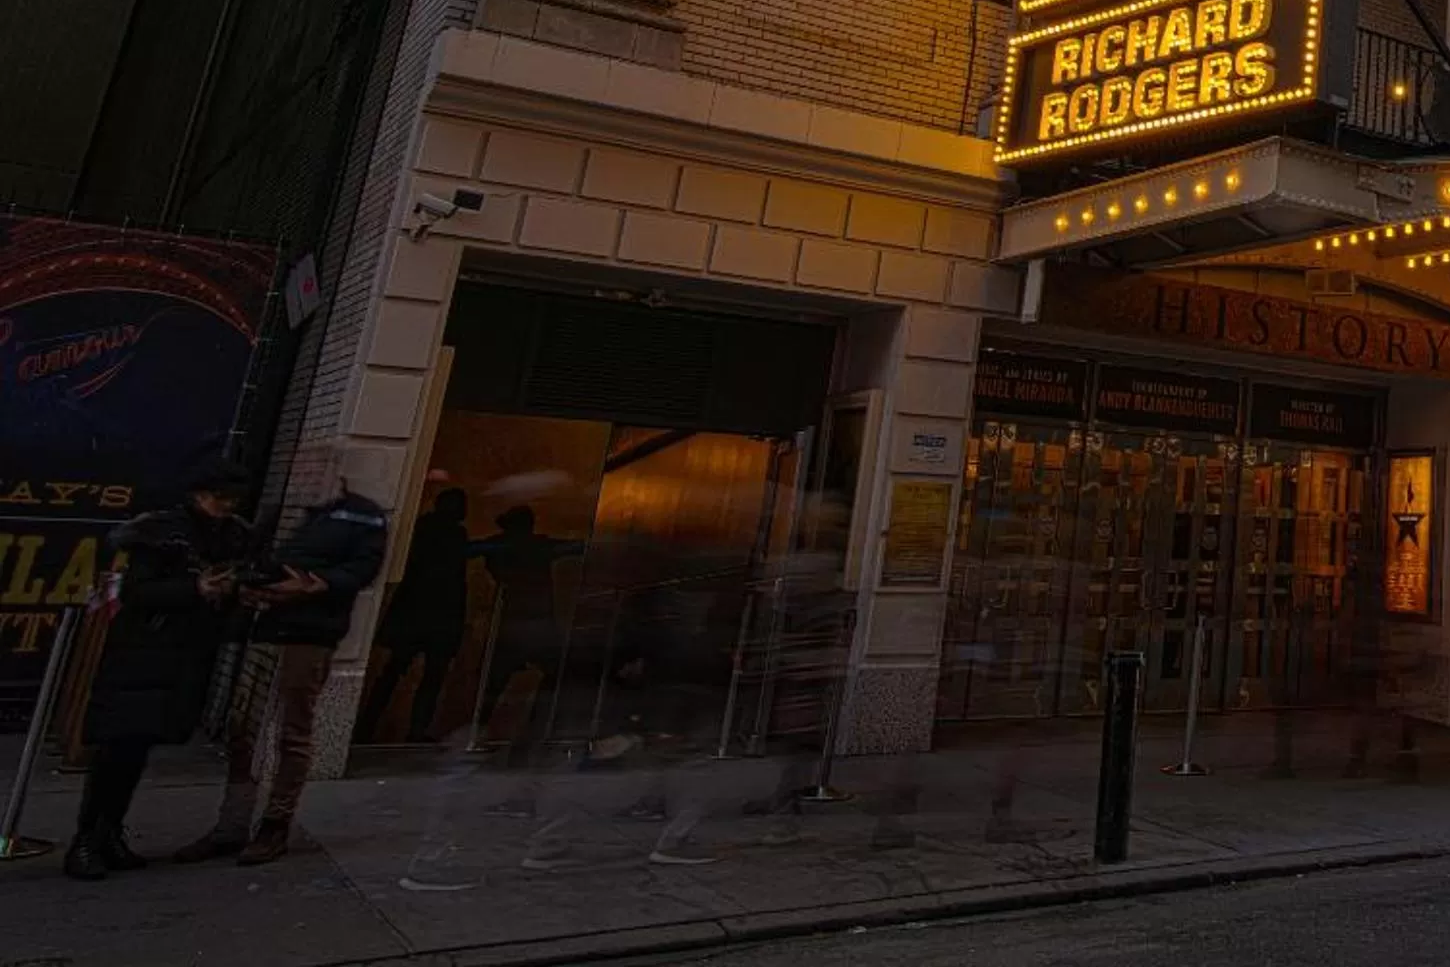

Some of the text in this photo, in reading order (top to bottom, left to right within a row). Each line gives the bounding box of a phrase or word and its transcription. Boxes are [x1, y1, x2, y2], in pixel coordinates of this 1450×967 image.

[1037, 42, 1277, 141] RODGERS
[1153, 284, 1449, 371] HISTORY
[0, 480, 135, 509] AY'S
[0, 534, 100, 606] LA
